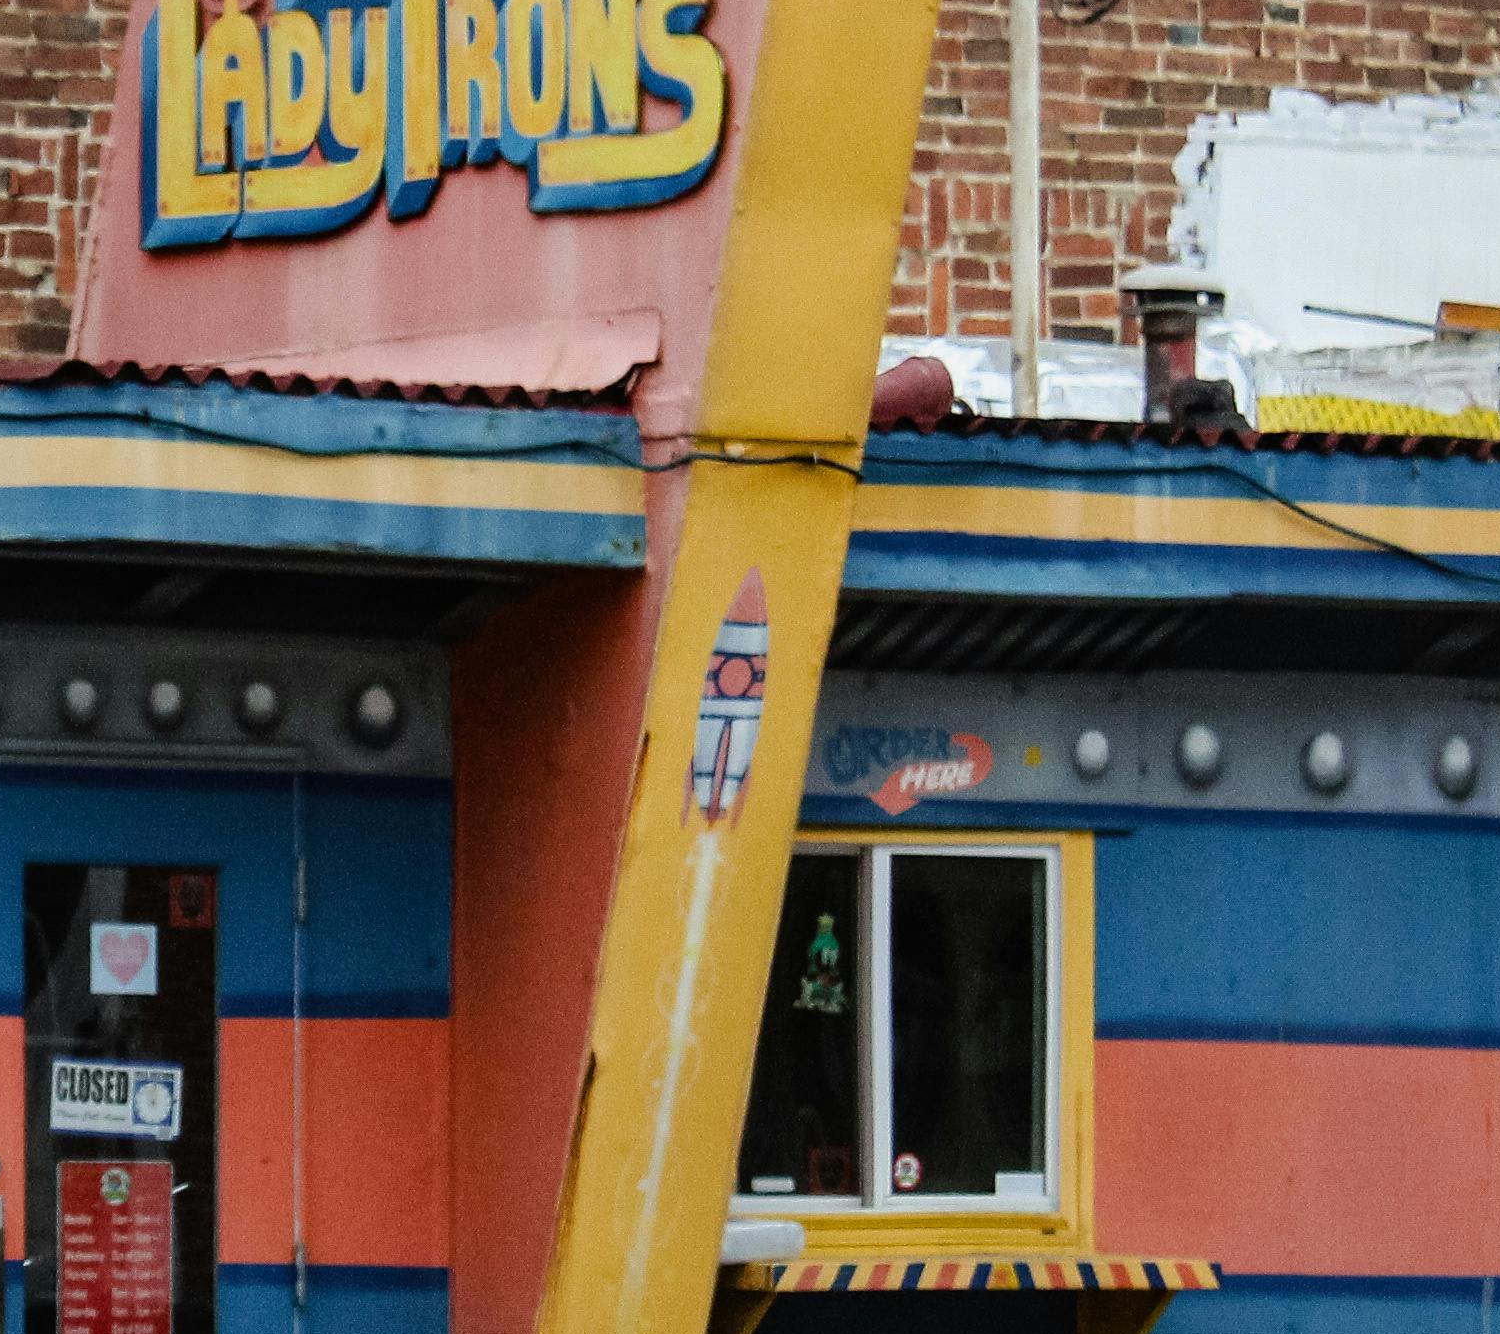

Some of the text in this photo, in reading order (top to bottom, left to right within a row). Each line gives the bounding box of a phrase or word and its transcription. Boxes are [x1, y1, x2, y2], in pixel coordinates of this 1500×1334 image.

[822, 723, 950, 786] ORDER
[900, 760, 975, 793] HERE
[56, 1066, 129, 1104] CLOSED
